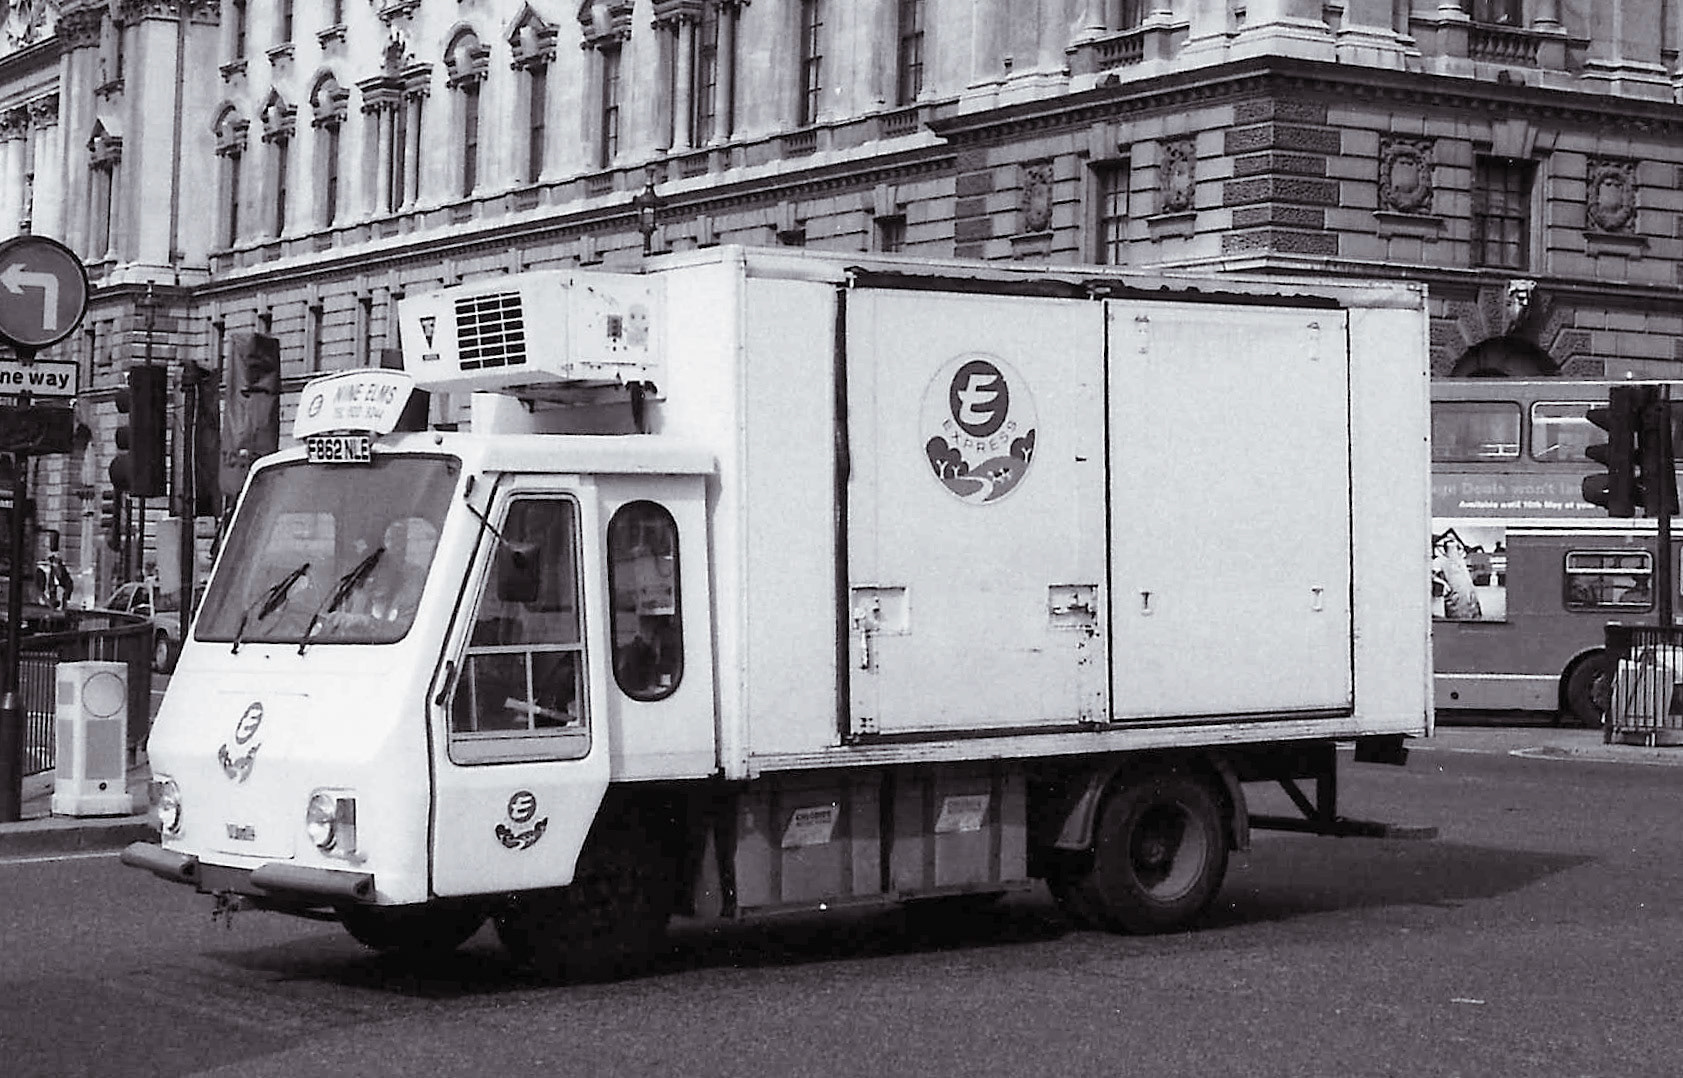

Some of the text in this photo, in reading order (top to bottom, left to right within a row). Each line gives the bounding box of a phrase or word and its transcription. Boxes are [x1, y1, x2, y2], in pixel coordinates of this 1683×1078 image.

[0, 371, 70, 389] ne way
[334, 383, 398, 405] NINE ELMS
[957, 374, 999, 426] E
[942, 419, 1018, 454] EXPRESS
[308, 438, 343, 460] F862
[1511, 481, 1556, 495] won't
[1458, 500, 1498, 509] Available
[1544, 500, 1562, 511] May
